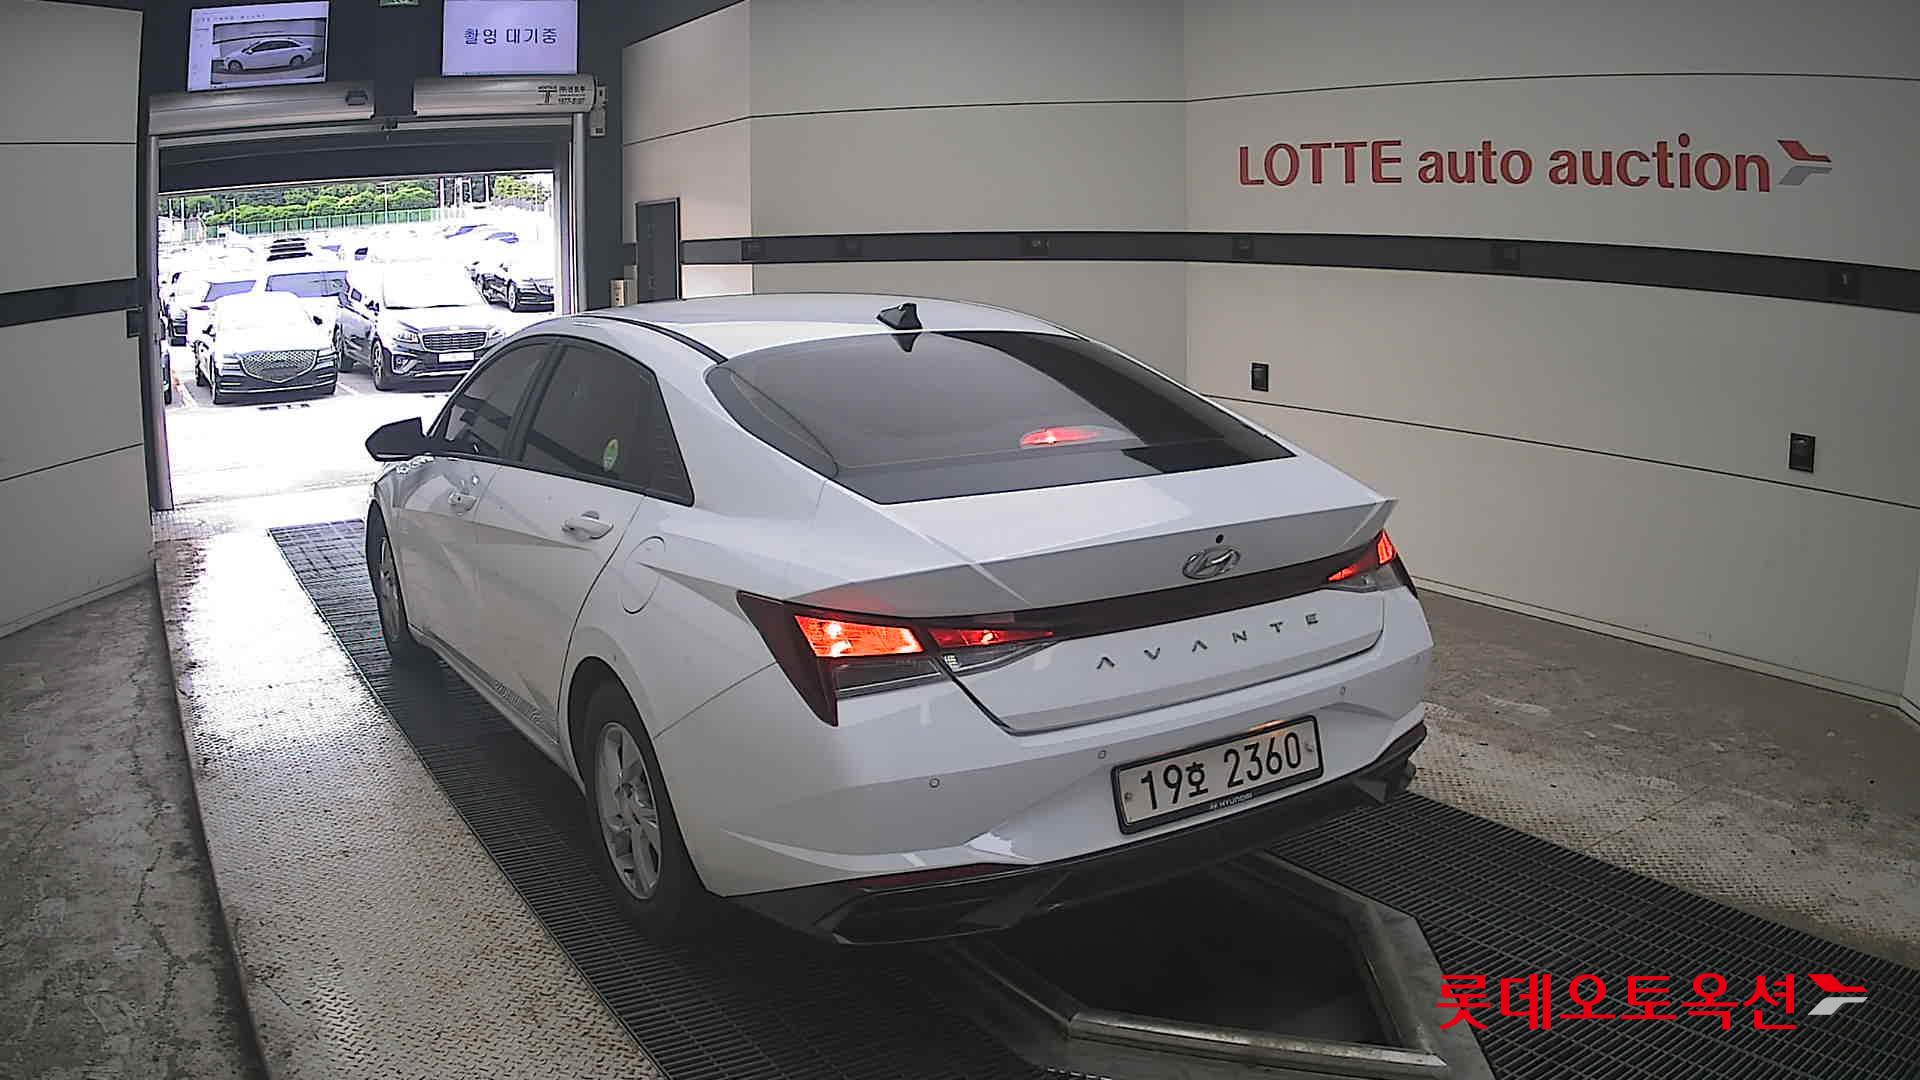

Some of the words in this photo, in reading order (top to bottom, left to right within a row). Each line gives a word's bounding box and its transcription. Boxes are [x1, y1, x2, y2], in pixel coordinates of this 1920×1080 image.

[505, 28, 558, 45] 대기중
[1239, 140, 1402, 187] LOTTE
[1418, 140, 1533, 185] auto
[1548, 132, 1771, 193] auction
[1096, 612, 1320, 670] AVANTE
[1140, 761, 1209, 811] 19호
[1224, 732, 1302, 788] 2360
